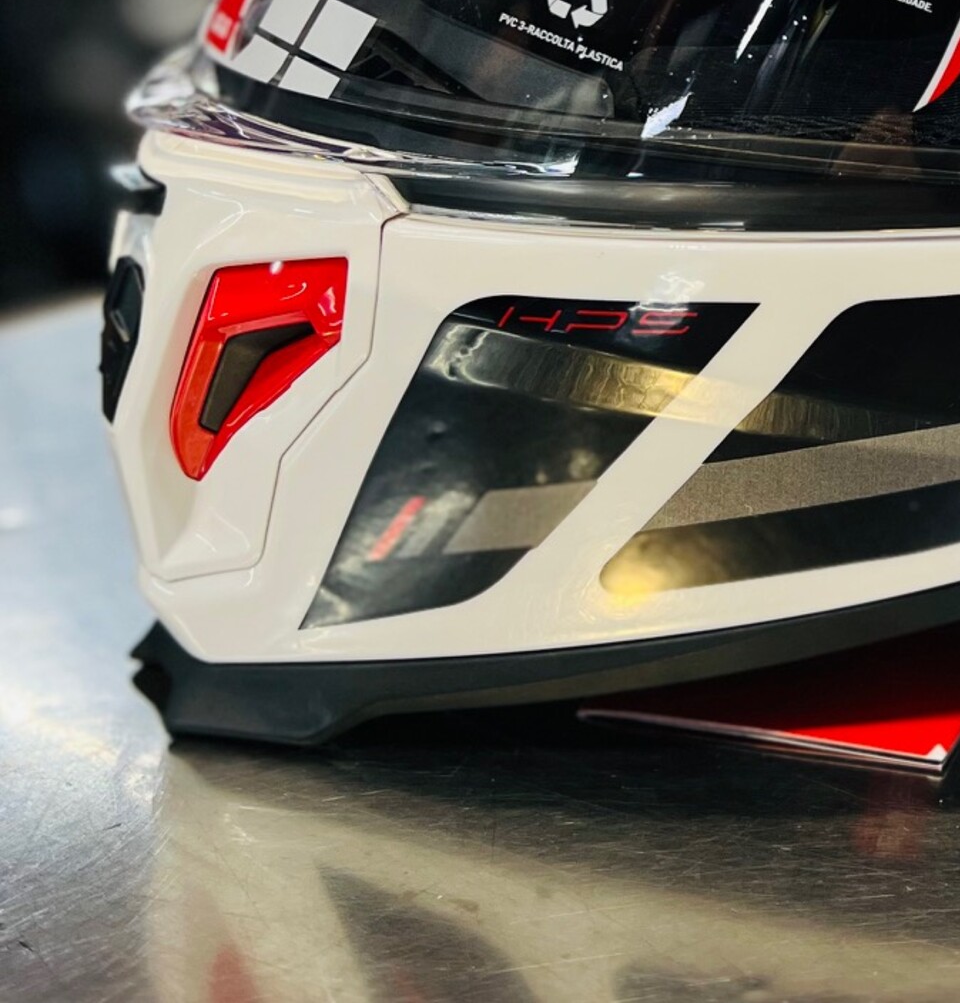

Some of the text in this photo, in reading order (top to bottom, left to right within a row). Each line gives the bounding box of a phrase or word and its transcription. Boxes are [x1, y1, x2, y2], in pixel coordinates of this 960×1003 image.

[499, 12, 624, 72] PVC 3-RACCOLTA PLASTICA
